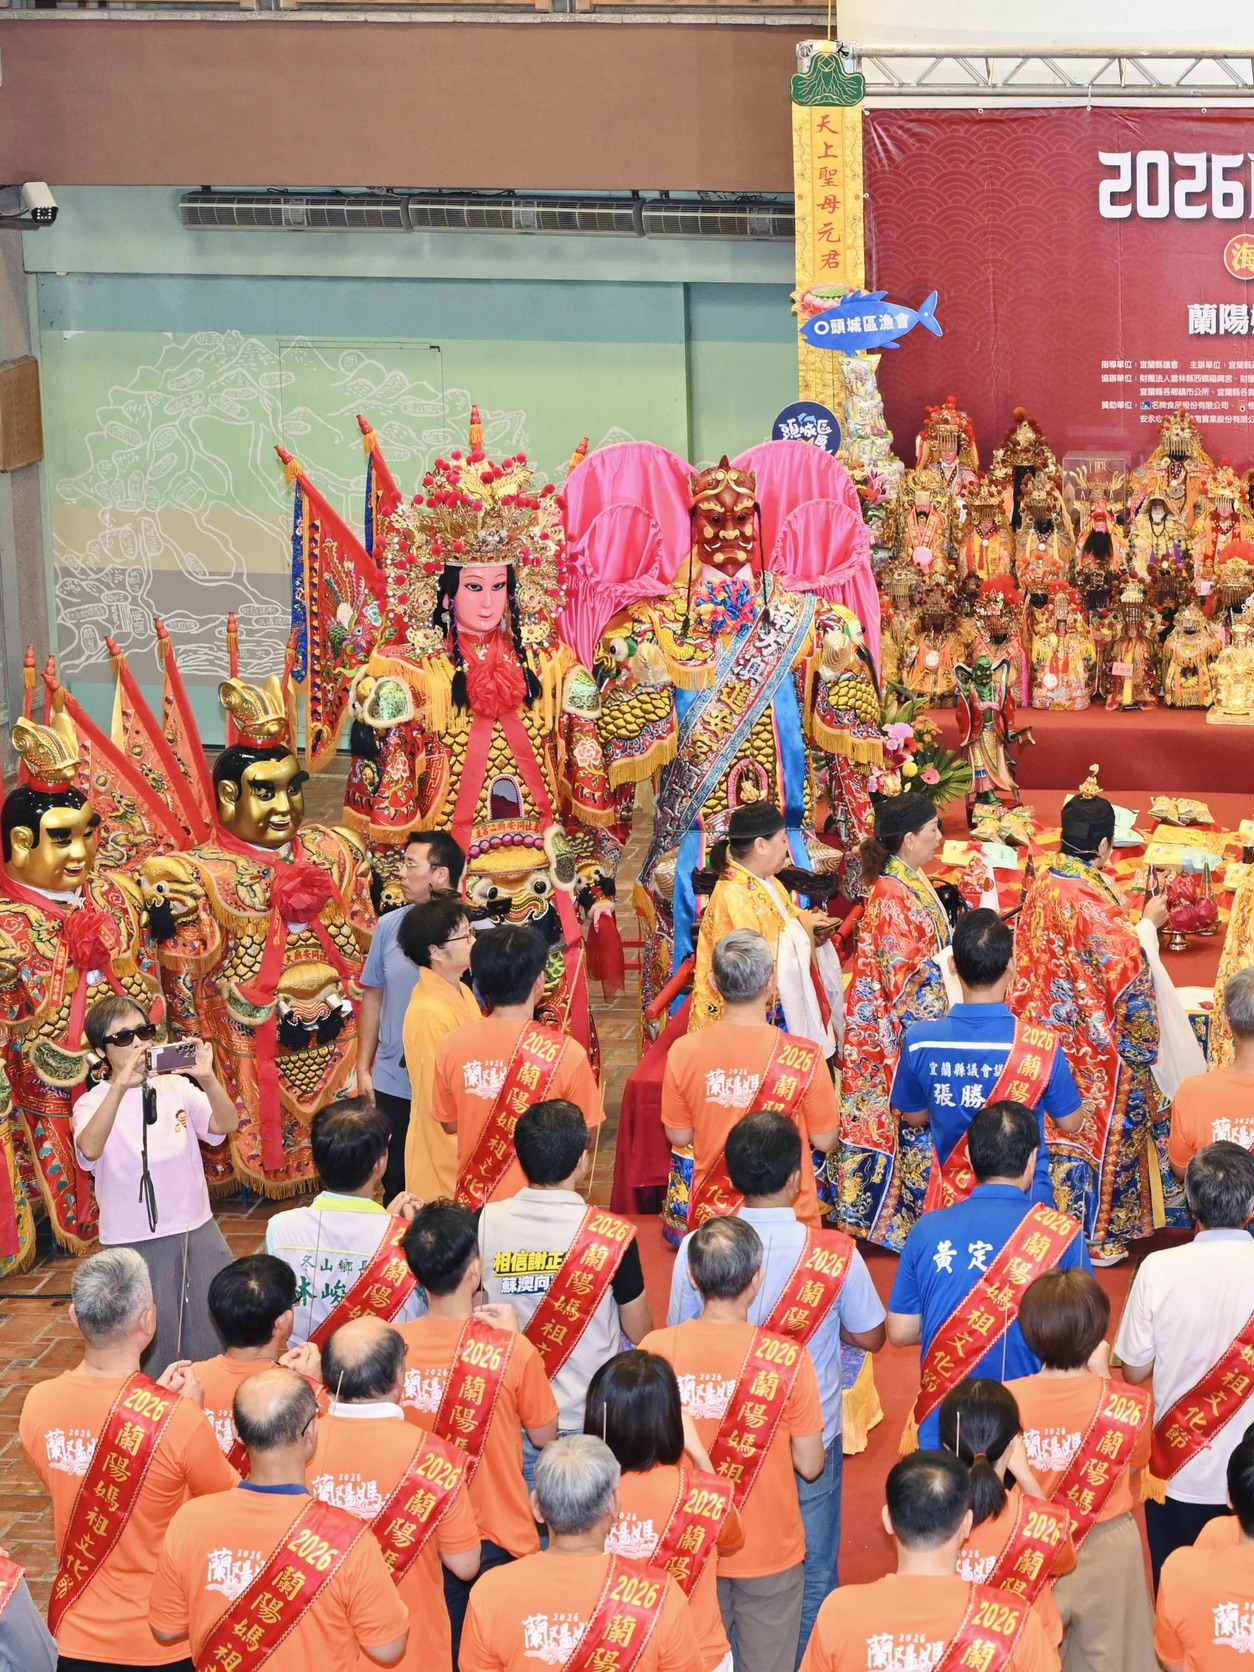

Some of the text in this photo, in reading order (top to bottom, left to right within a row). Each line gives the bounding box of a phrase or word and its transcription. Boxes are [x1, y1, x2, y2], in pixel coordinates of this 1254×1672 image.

[814, 113, 842, 271] 天上聖母元君
[830, 312, 910, 335] 頭城區漁會
[522, 1031, 559, 1064] 2026
[1021, 1025, 1055, 1052] 2026
[728, 1068, 749, 1076] 2026
[777, 1043, 814, 1074] 2026
[587, 1214, 629, 1242] 2026
[804, 1248, 845, 1278] 2026
[932, 1240, 993, 1275] 黃定
[500, 1273, 550, 1295] 蘇澳向
[921, 1206, 1072, 1394] 2026 蘭陽媽祖文化節
[461, 1339, 503, 1371] 2026
[754, 1337, 799, 1367] 2026
[404, 1368, 448, 1401] 2026 蘭陽
[700, 1372, 722, 1382] 2026
[1103, 1394, 1142, 1427] 2026
[69, 1428, 92, 1437] 2026
[1043, 1426, 1067, 1436] 2026
[416, 1453, 462, 1490] 2026
[54, 1387, 170, 1601] 2026 蘭陽媽祖文化節
[311, 1473, 392, 1504] 2026 蘭陽媽
[683, 1488, 727, 1521] 2026
[1022, 1511, 1064, 1545] 2026
[236, 1549, 262, 1560] 2026
[203, 1529, 339, 1672] 2026 蘭陽媽祖
[609, 1574, 659, 1609] 2026
[552, 1612, 580, 1622] 2026
[899, 1632, 926, 1644] 2026
[960, 1600, 1020, 1671] 2026 蘭
